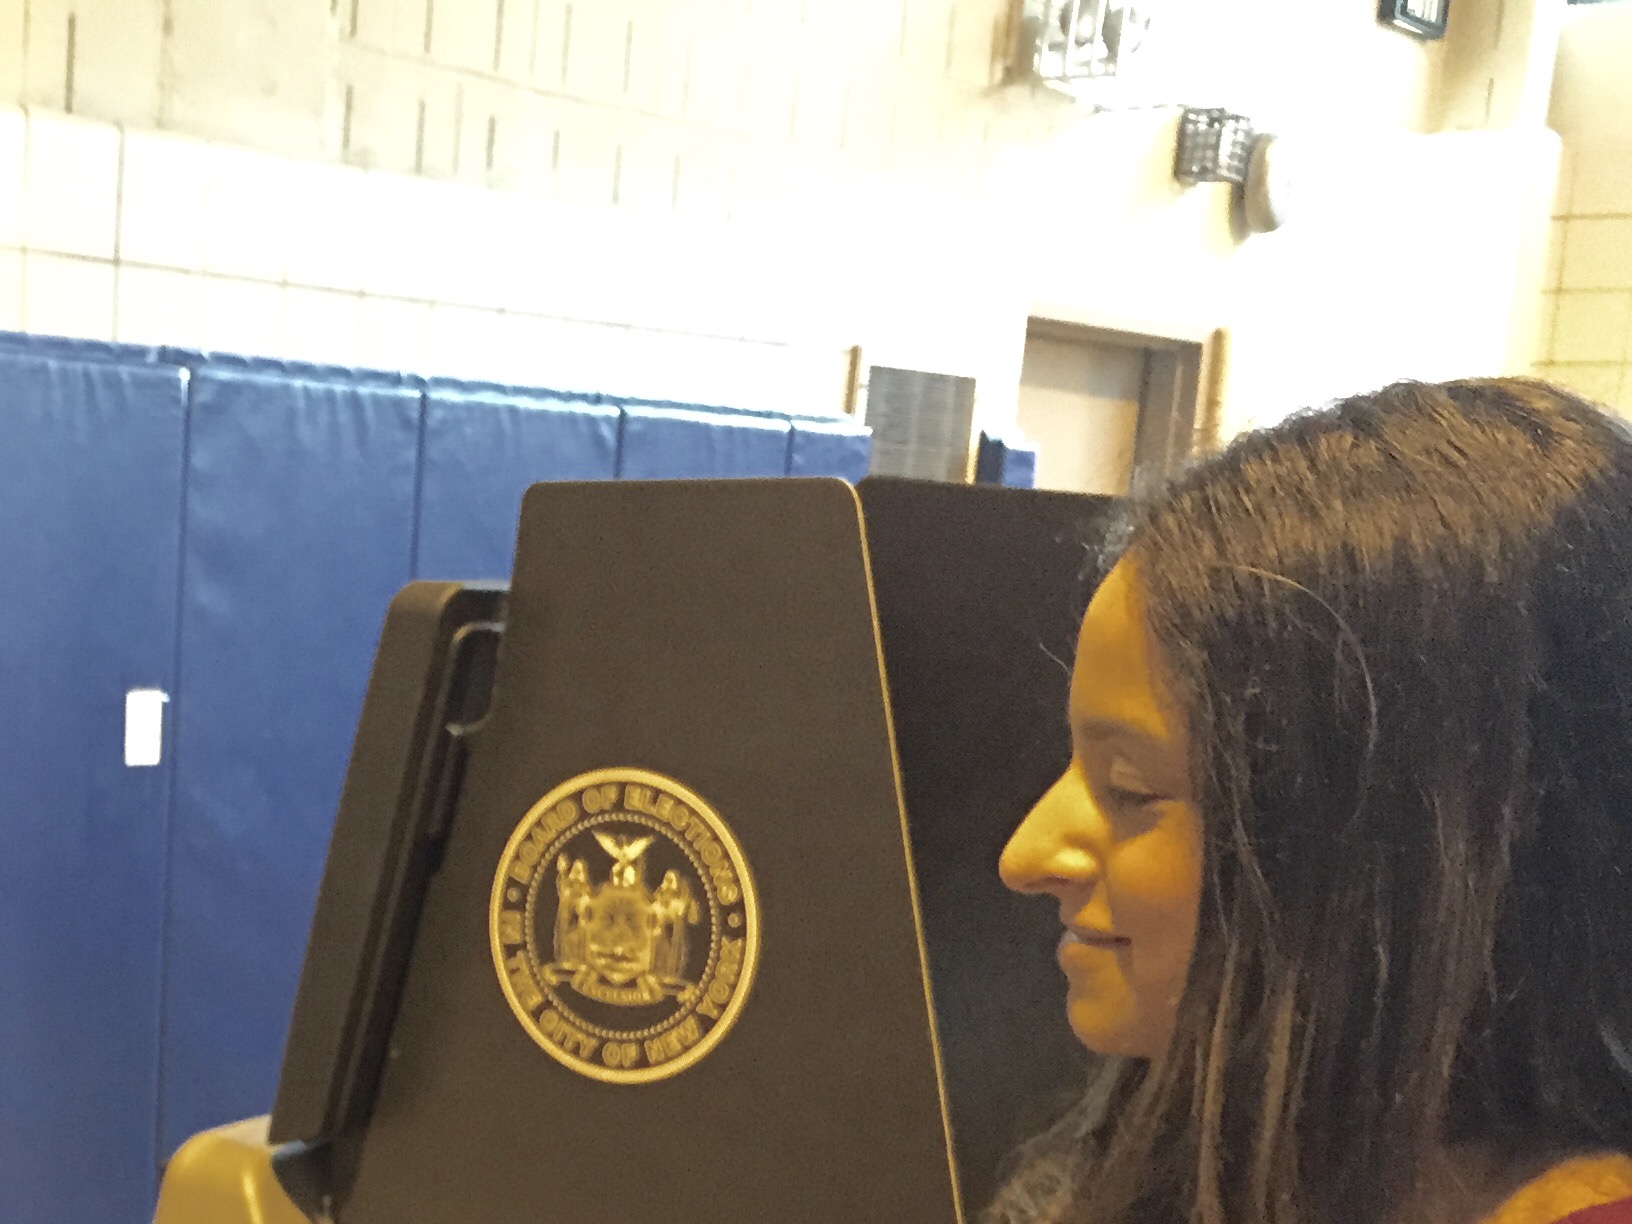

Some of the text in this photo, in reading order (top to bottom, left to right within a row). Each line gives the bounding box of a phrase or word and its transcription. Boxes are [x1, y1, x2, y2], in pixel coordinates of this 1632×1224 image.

[510, 784, 739, 906] BOARD OF ELECTIONS
[539, 1008, 598, 1057] CITY
[602, 1041, 640, 1068] OF
[644, 1016, 702, 1064] NEW
[696, 935, 742, 1020] YORK
